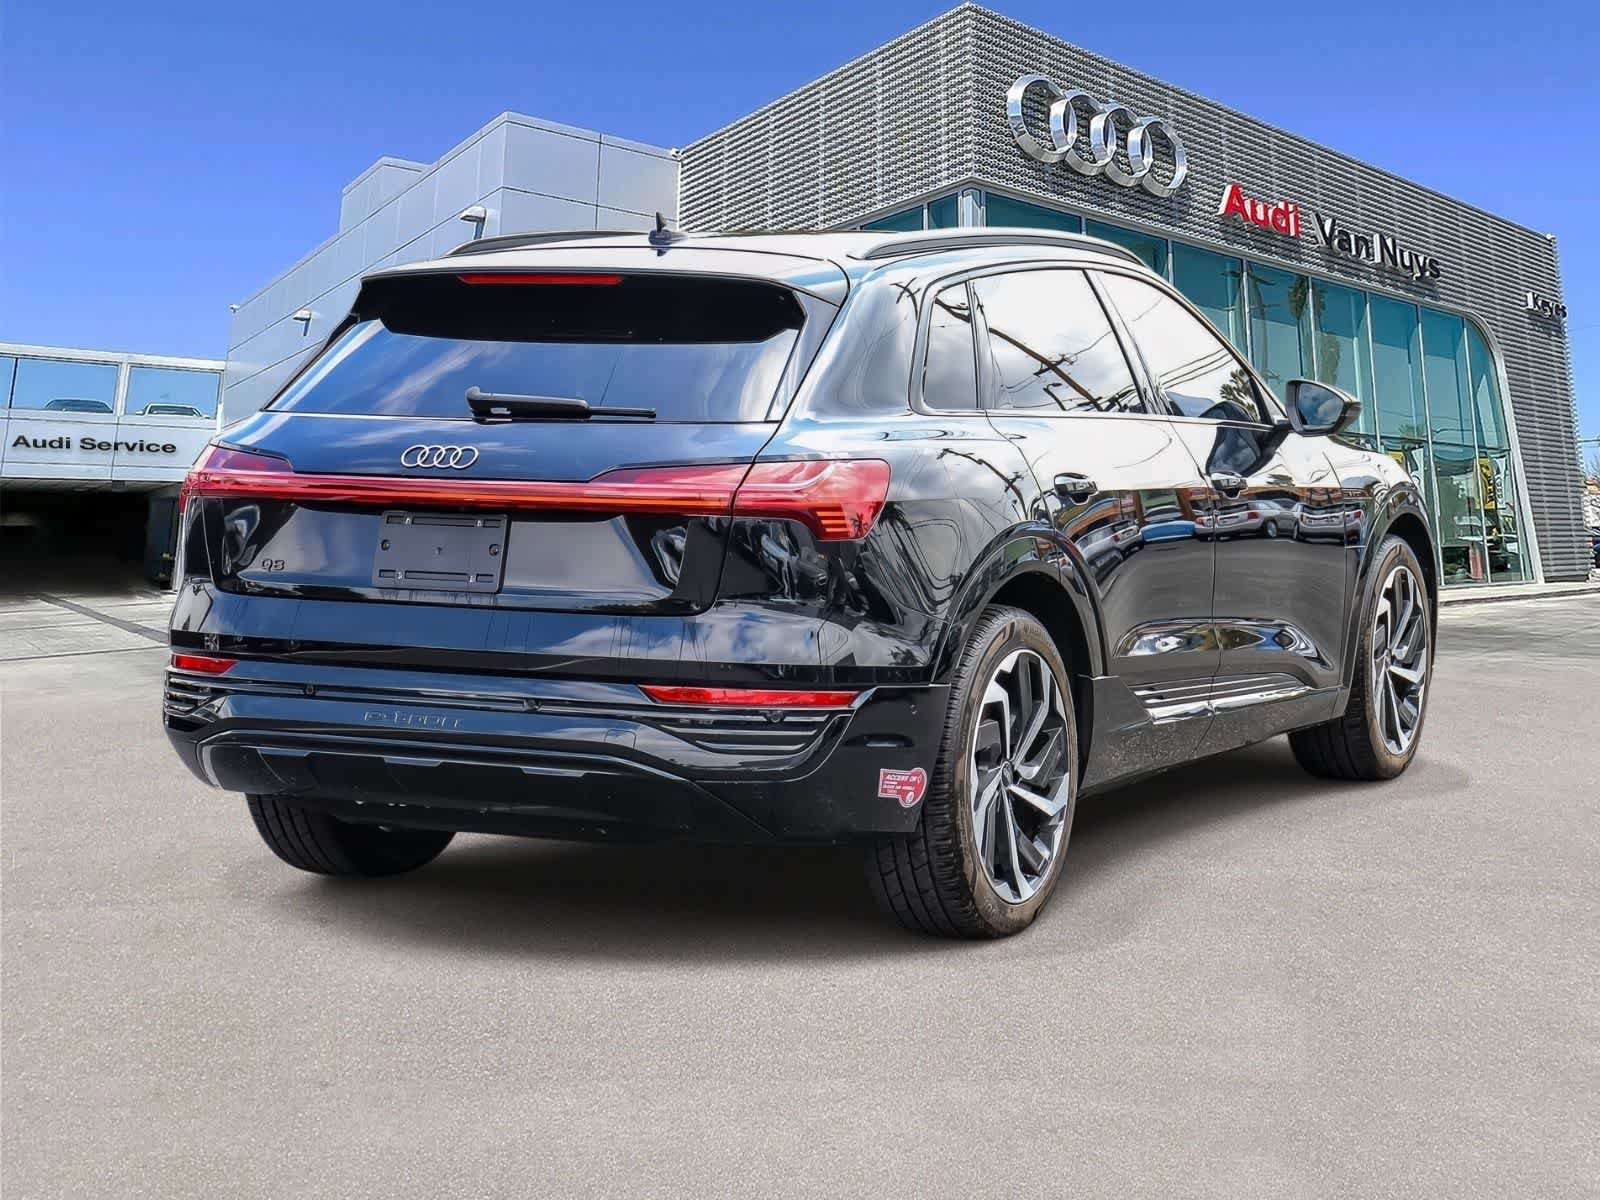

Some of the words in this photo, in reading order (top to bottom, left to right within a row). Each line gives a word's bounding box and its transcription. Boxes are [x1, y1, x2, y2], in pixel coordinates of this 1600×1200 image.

[1219, 182, 1301, 236] Audi
[1312, 211, 1373, 260] Van
[1374, 232, 1440, 280] Nuys
[1526, 291, 1567, 318] Keyes
[12, 435, 71, 449] Audi
[79, 437, 177, 453] Service
